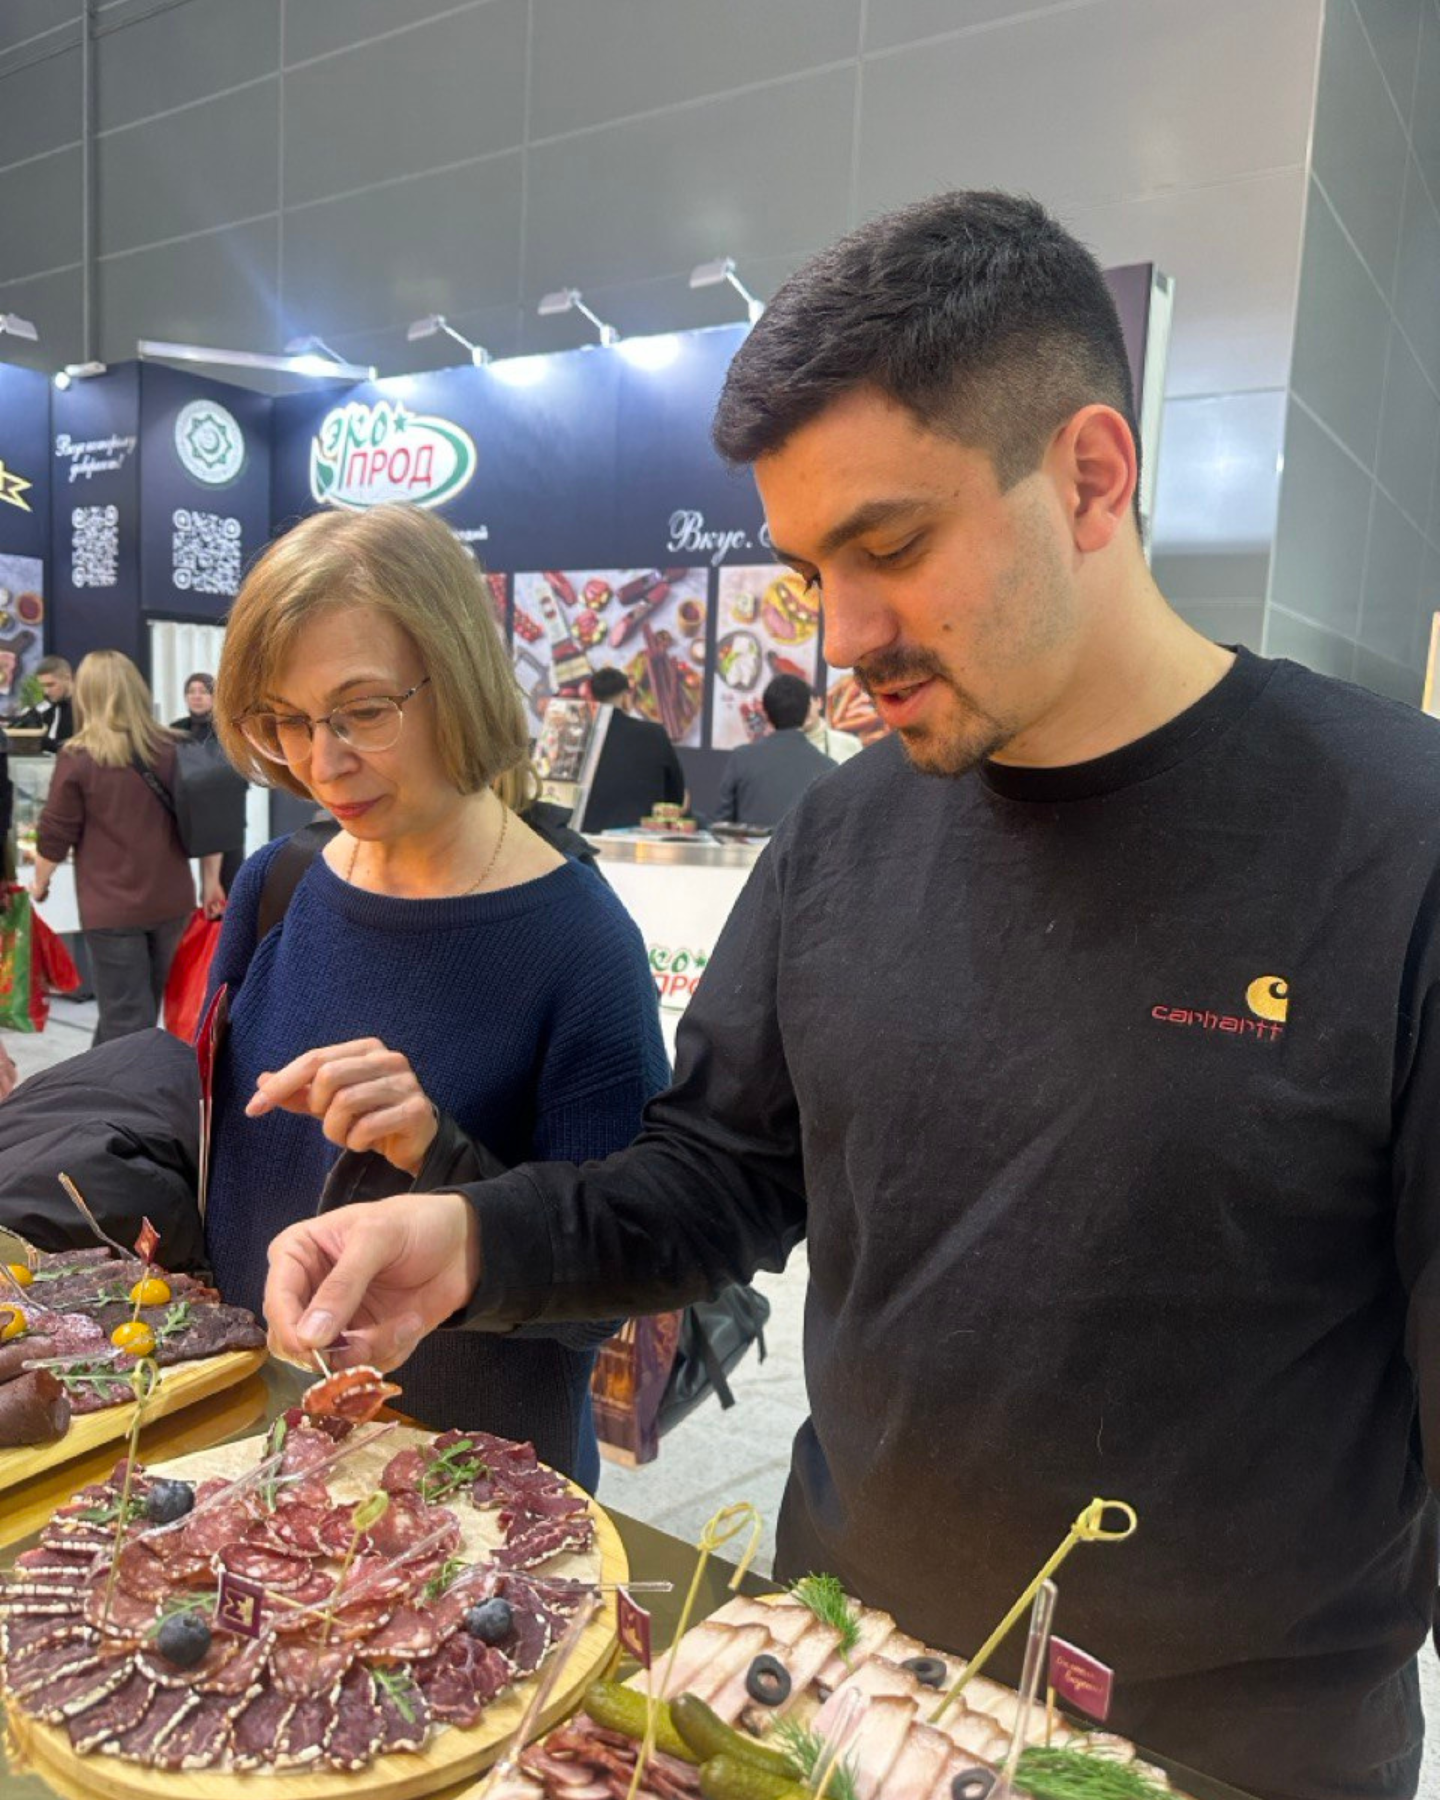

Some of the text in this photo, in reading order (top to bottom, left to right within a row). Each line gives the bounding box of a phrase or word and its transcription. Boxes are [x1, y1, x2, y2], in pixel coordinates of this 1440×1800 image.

[346, 444, 434, 490] ПРОД
[666, 509, 753, 566] Вкус.
[1151, 1005, 1283, 1041] carhartt
